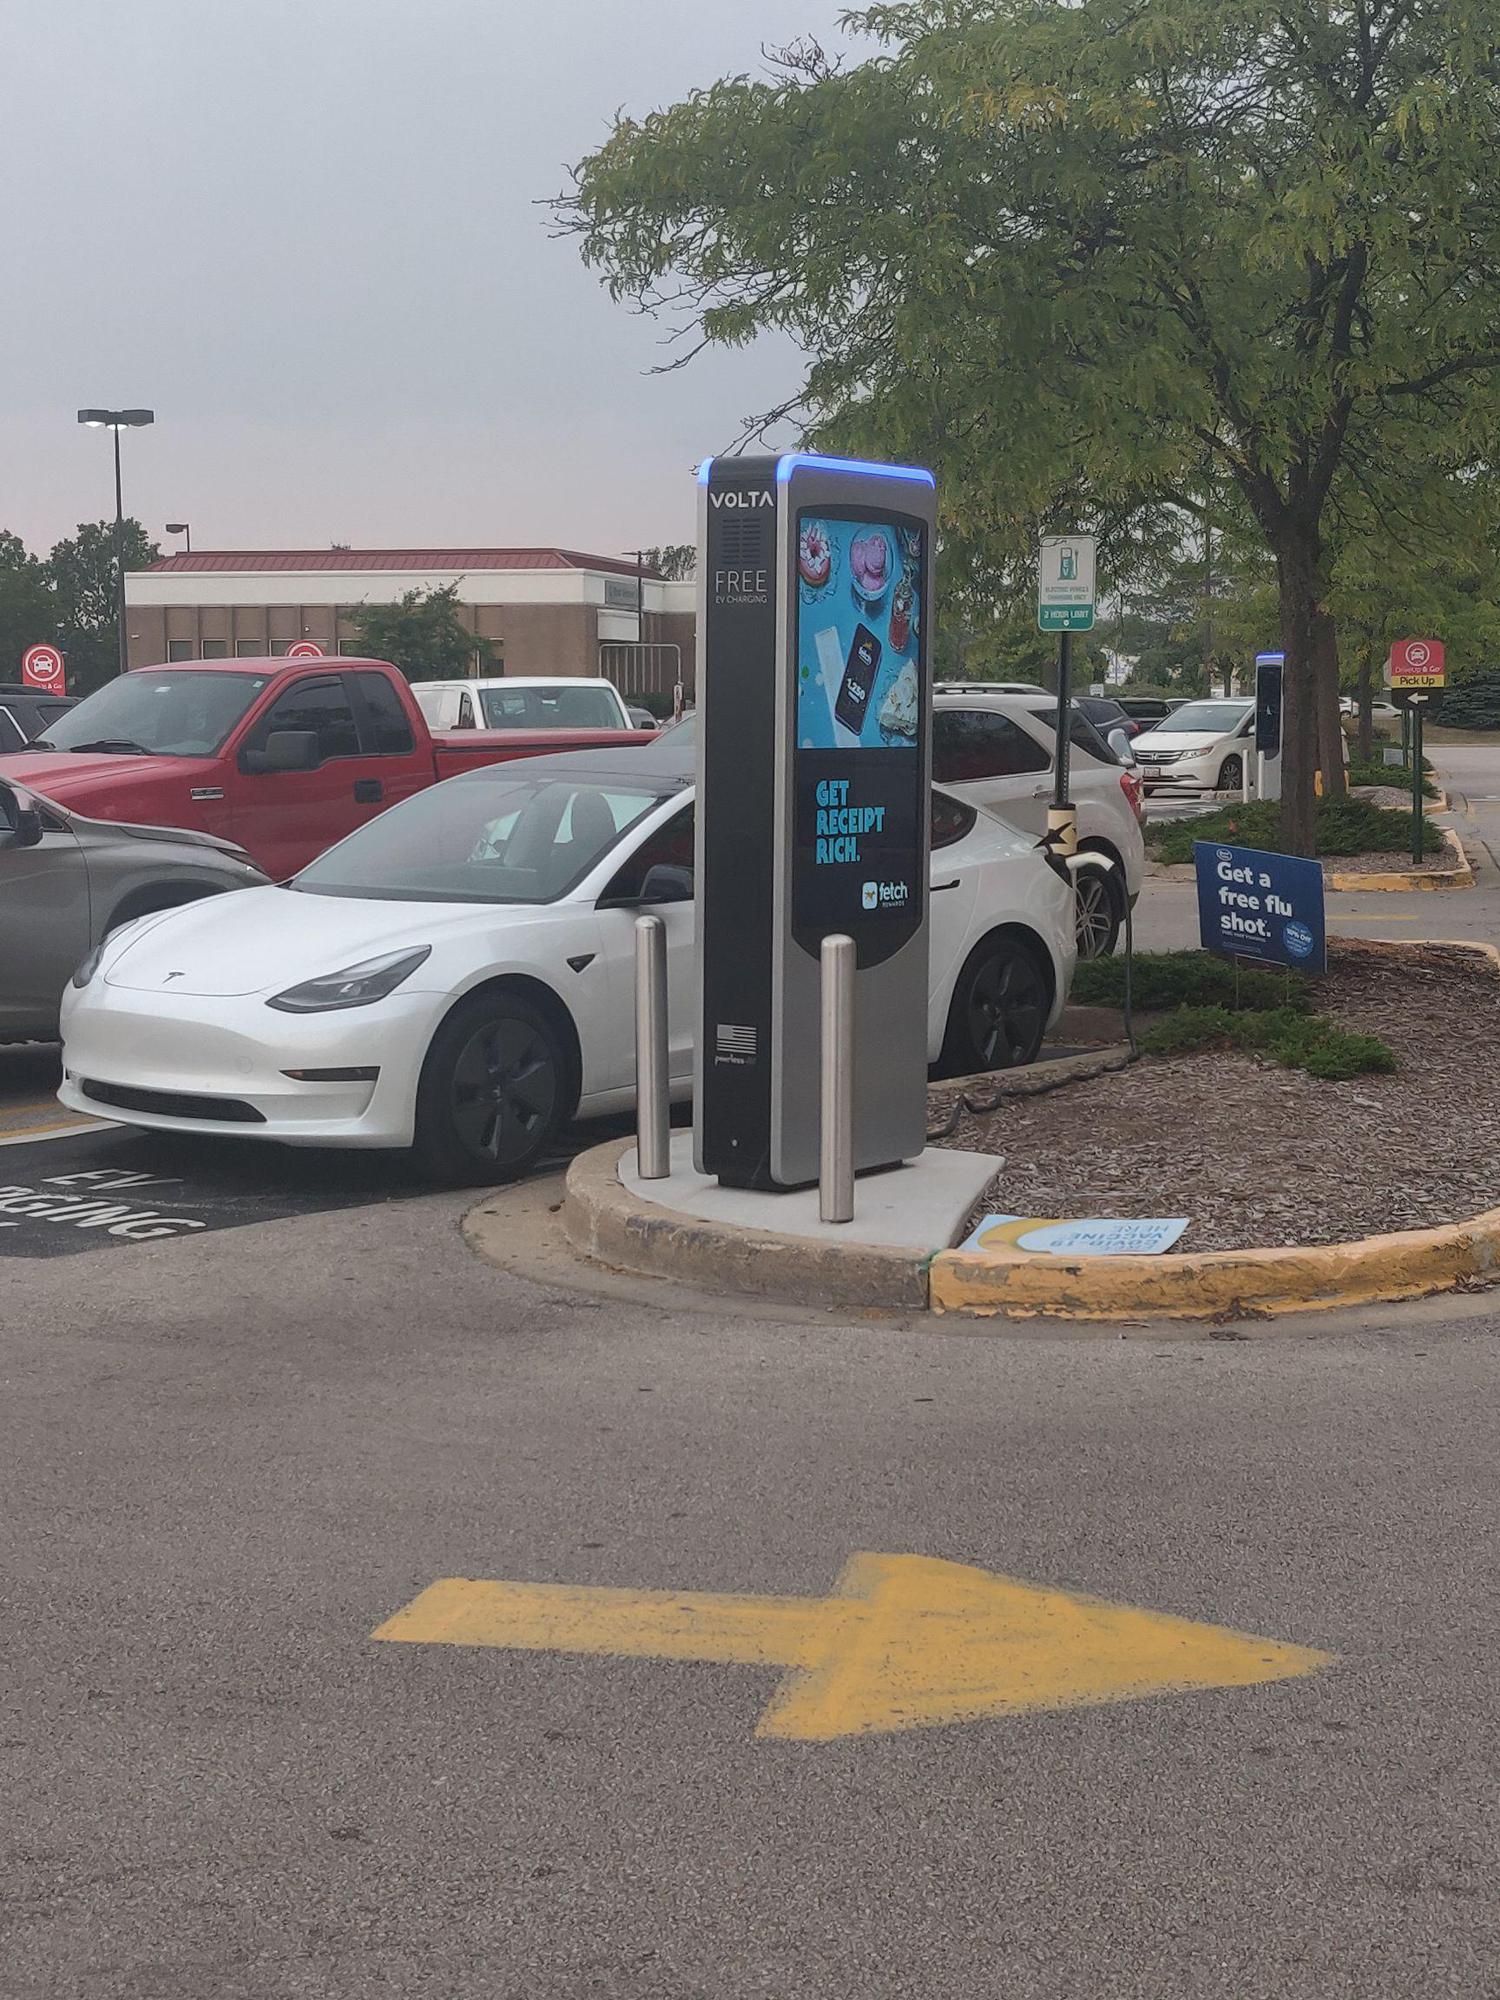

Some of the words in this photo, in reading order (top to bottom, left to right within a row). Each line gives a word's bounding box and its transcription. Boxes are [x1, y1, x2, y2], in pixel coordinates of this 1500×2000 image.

[710, 491, 774, 508] VOLTA
[715, 570, 767, 593] FREE
[1044, 611, 1049, 619] 2
[1051, 611, 1069, 619] HOUR
[1400, 676, 1420, 684] Pick
[1421, 676, 1435, 685] Up
[816, 780, 849, 807] GET
[816, 807, 885, 836] RECEIPT
[816, 837, 861, 864] RICH.
[1217, 861, 1254, 885] Get
[1259, 873, 1271, 888] a
[879, 881, 908, 901] fetch
[1218, 886, 1260, 909] free
[1264, 894, 1293, 917] flu
[1220, 912, 1271, 937] shot.
[40, 1168, 184, 1190] EV
